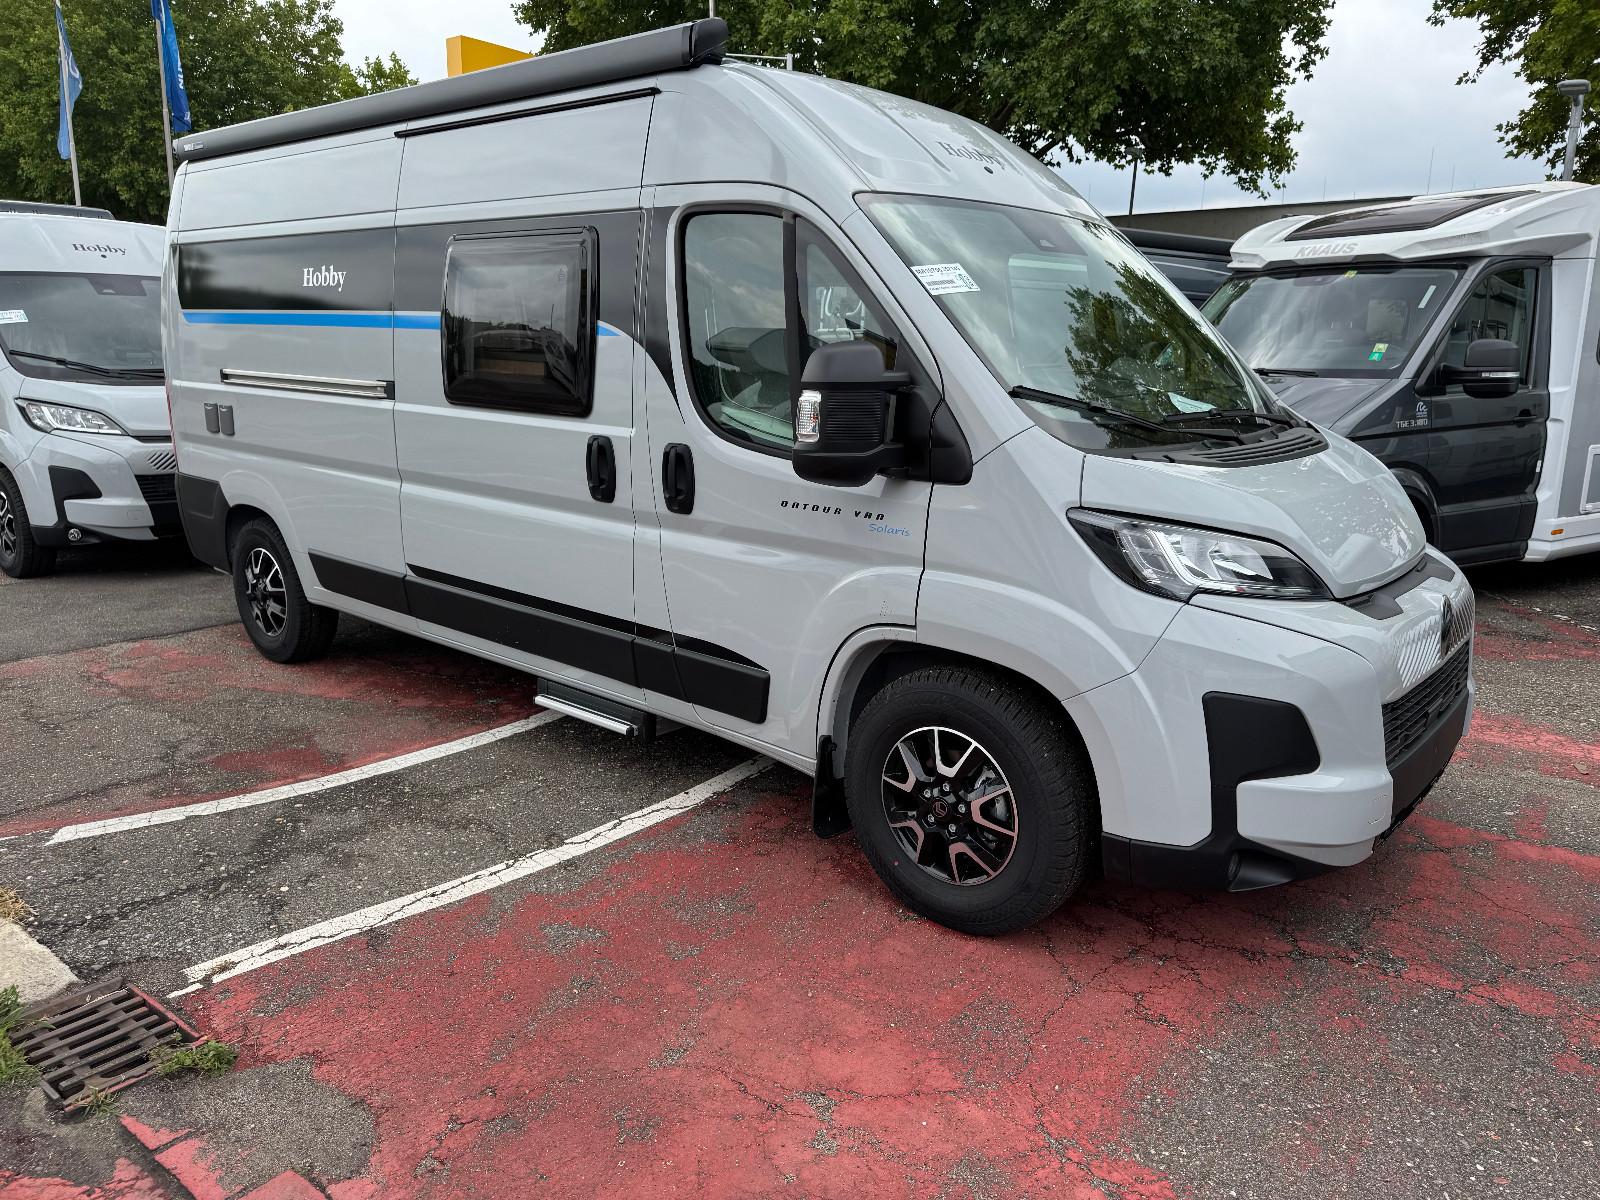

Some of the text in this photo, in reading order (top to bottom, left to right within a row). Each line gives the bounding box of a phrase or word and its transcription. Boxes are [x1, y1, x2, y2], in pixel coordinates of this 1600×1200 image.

[936, 141, 1005, 170] Hobby
[72, 243, 127, 256] Hobby
[1295, 243, 1359, 258] KNAUS
[303, 264, 347, 292] Hobby
[854, 510, 885, 521] VAN
[868, 523, 912, 537] Solaris
